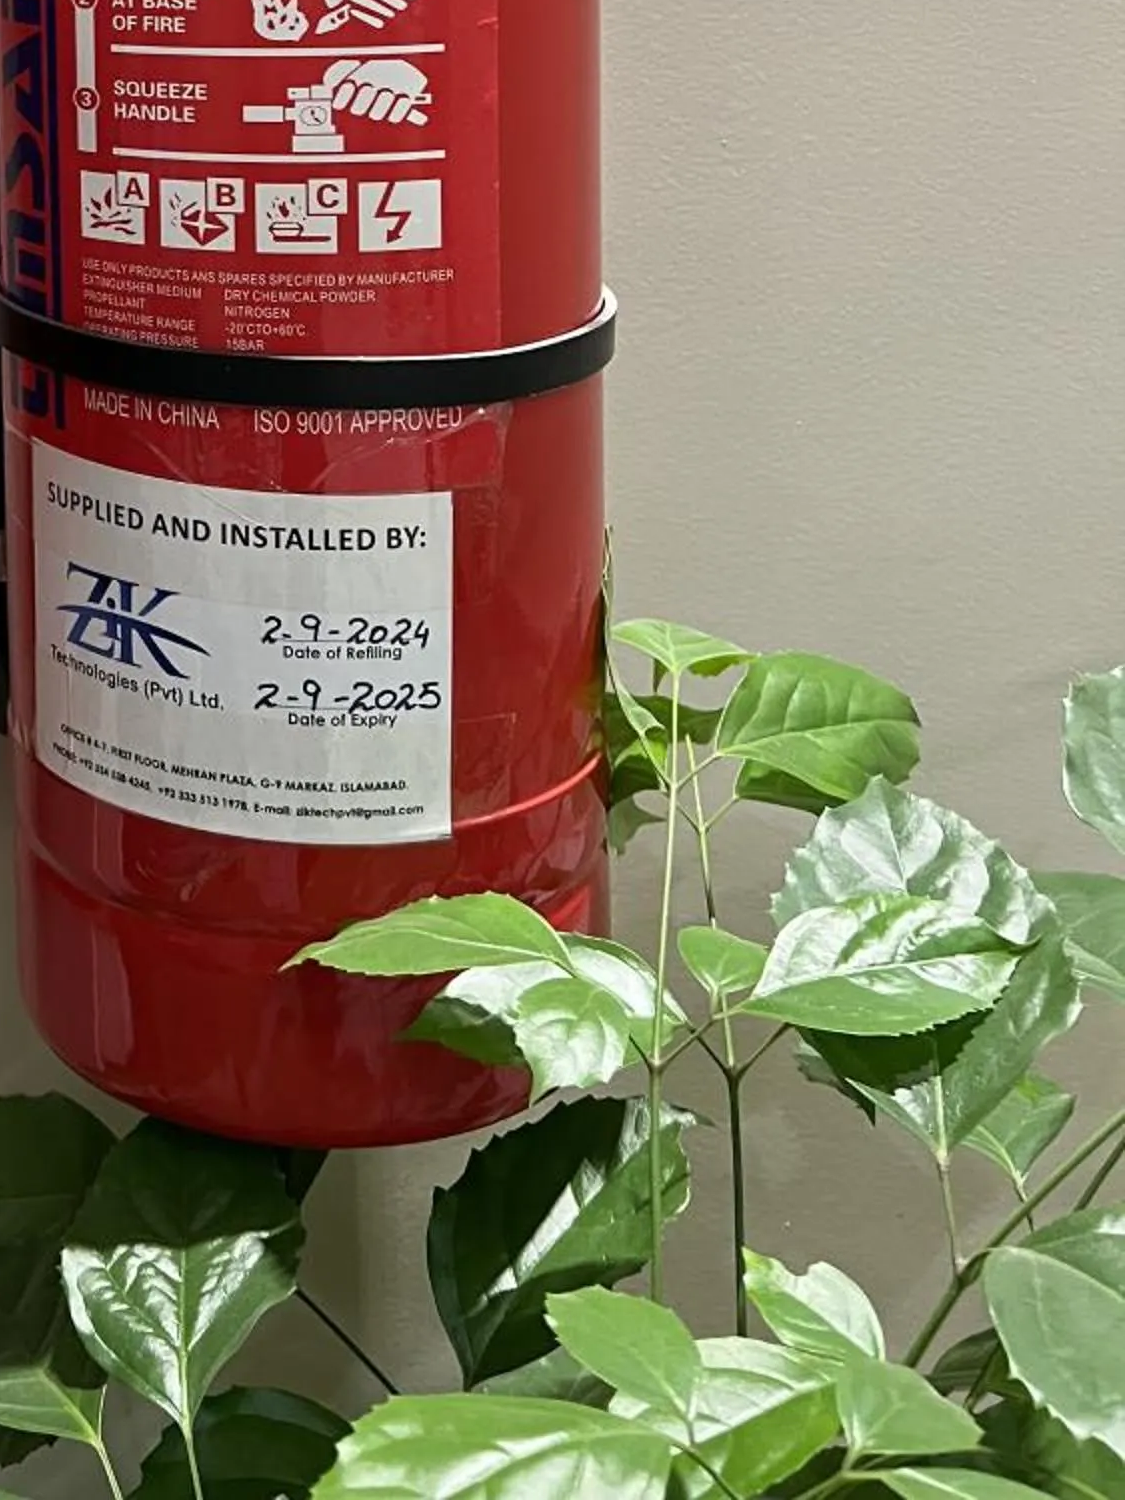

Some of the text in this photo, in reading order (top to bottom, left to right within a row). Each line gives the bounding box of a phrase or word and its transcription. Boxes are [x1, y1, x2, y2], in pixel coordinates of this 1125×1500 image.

[112, 15, 186, 33] OF FIRE
[80, 91, 93, 108] 3
[113, 80, 208, 101] SQUEEZE
[114, 104, 196, 124] HANDLE
[123, 178, 145, 200] A
[215, 184, 237, 207] B
[315, 184, 341, 209] C
[129, 263, 190, 282] PRODUCTS
[218, 272, 266, 286] SPARES
[269, 273, 335, 287] SPECIFIED
[338, 274, 355, 287] BY
[357, 268, 455, 286] MANUFACTURER
[82, 273, 376, 303] EXTINGUISHER MEDIUM DRY CHEMICAL POWDER
[83, 305, 154, 328] TEMPERATURE
[156, 316, 196, 332] RANGE
[225, 305, 291, 319] NITROGEN
[139, 330, 200, 349] PRESSURE
[84, 387, 462, 435] MADE IN CHINA ISO 9001 APPROVED
[47, 481, 427, 551] SUPPLIED AND INSTALLED BY:
[282, 646, 321, 659] Date
[326, 646, 342, 659] of
[51, 644, 139, 692] Technologies
[144, 680, 184, 707] (Pvt)
[288, 713, 398, 729] Date of Expiry
[171, 765, 217, 782] MEHRAN
